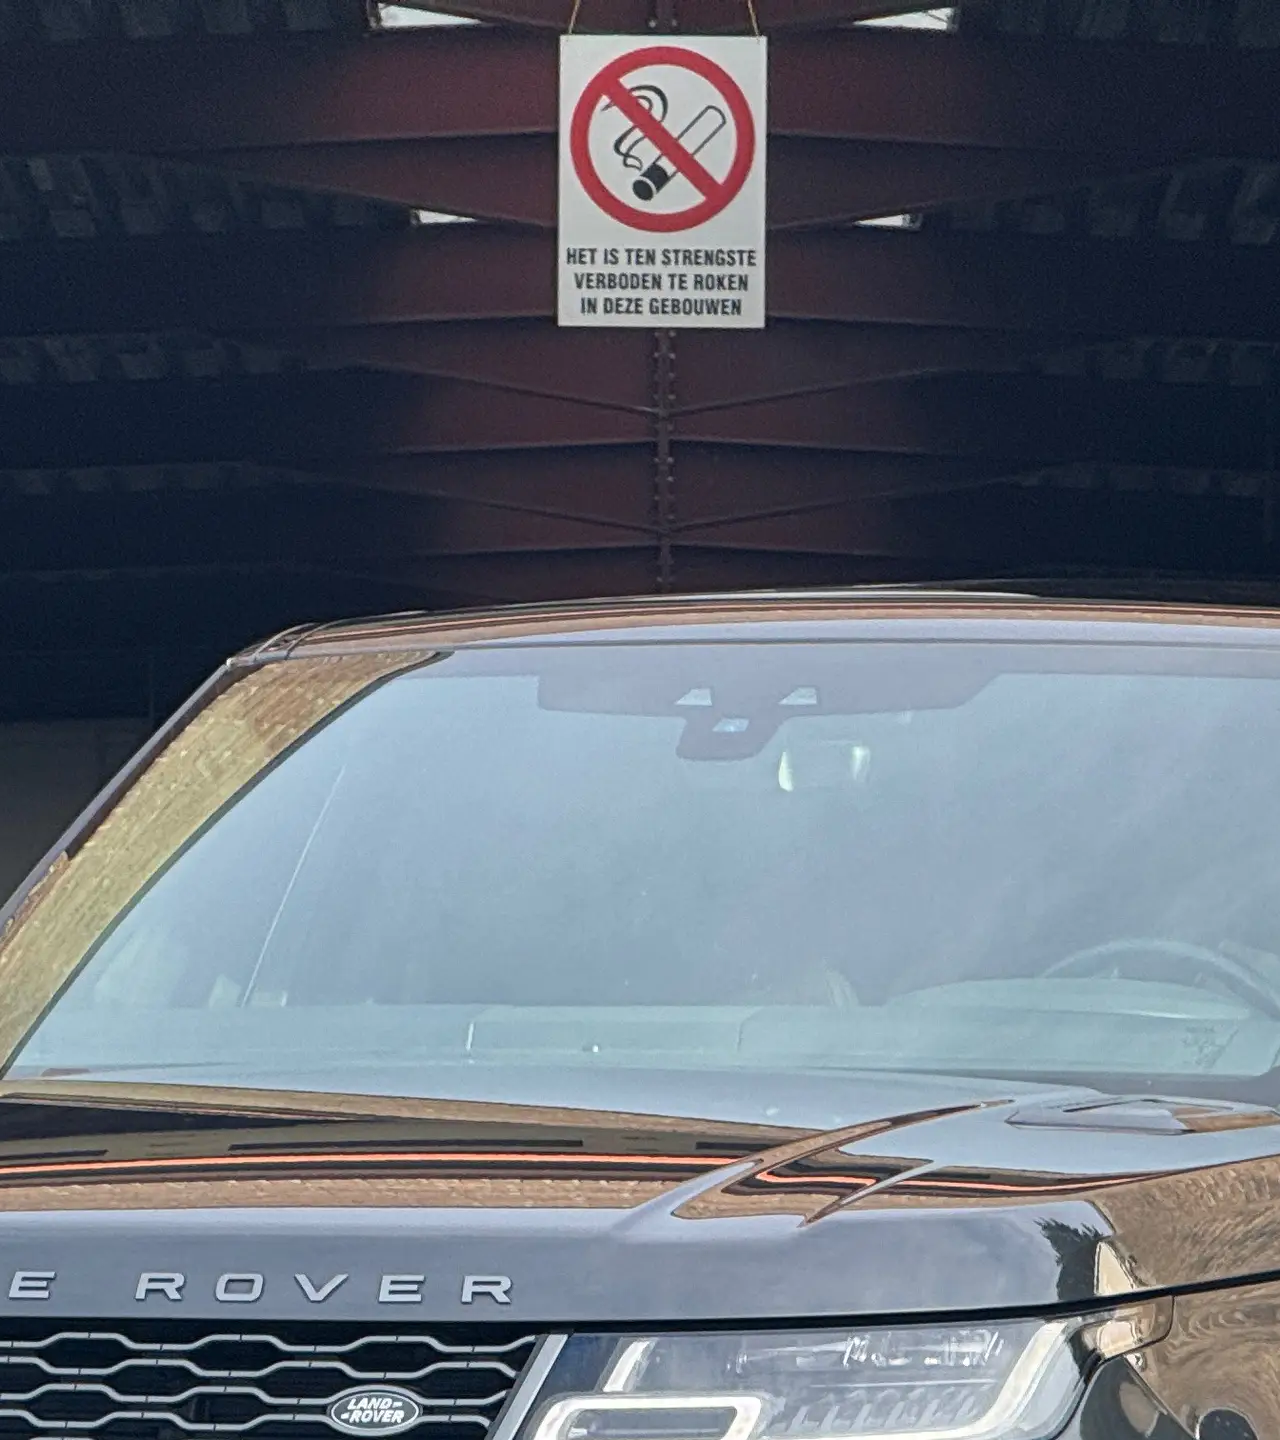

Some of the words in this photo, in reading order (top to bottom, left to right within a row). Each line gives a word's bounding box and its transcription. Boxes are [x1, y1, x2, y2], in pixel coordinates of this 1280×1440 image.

[567, 248, 597, 265] HET
[604, 248, 619, 265] IS
[625, 248, 656, 265] TEN
[661, 248, 757, 266] STRENGSTE
[574, 273, 662, 290] VERBODEN
[668, 273, 688, 290] TE
[693, 273, 748, 291] ROKEN
[581, 298, 597, 315] IN
[603, 298, 643, 315] DEZE
[649, 298, 742, 316] GEBOUWEN
[135, 1272, 516, 1306] ROVER
